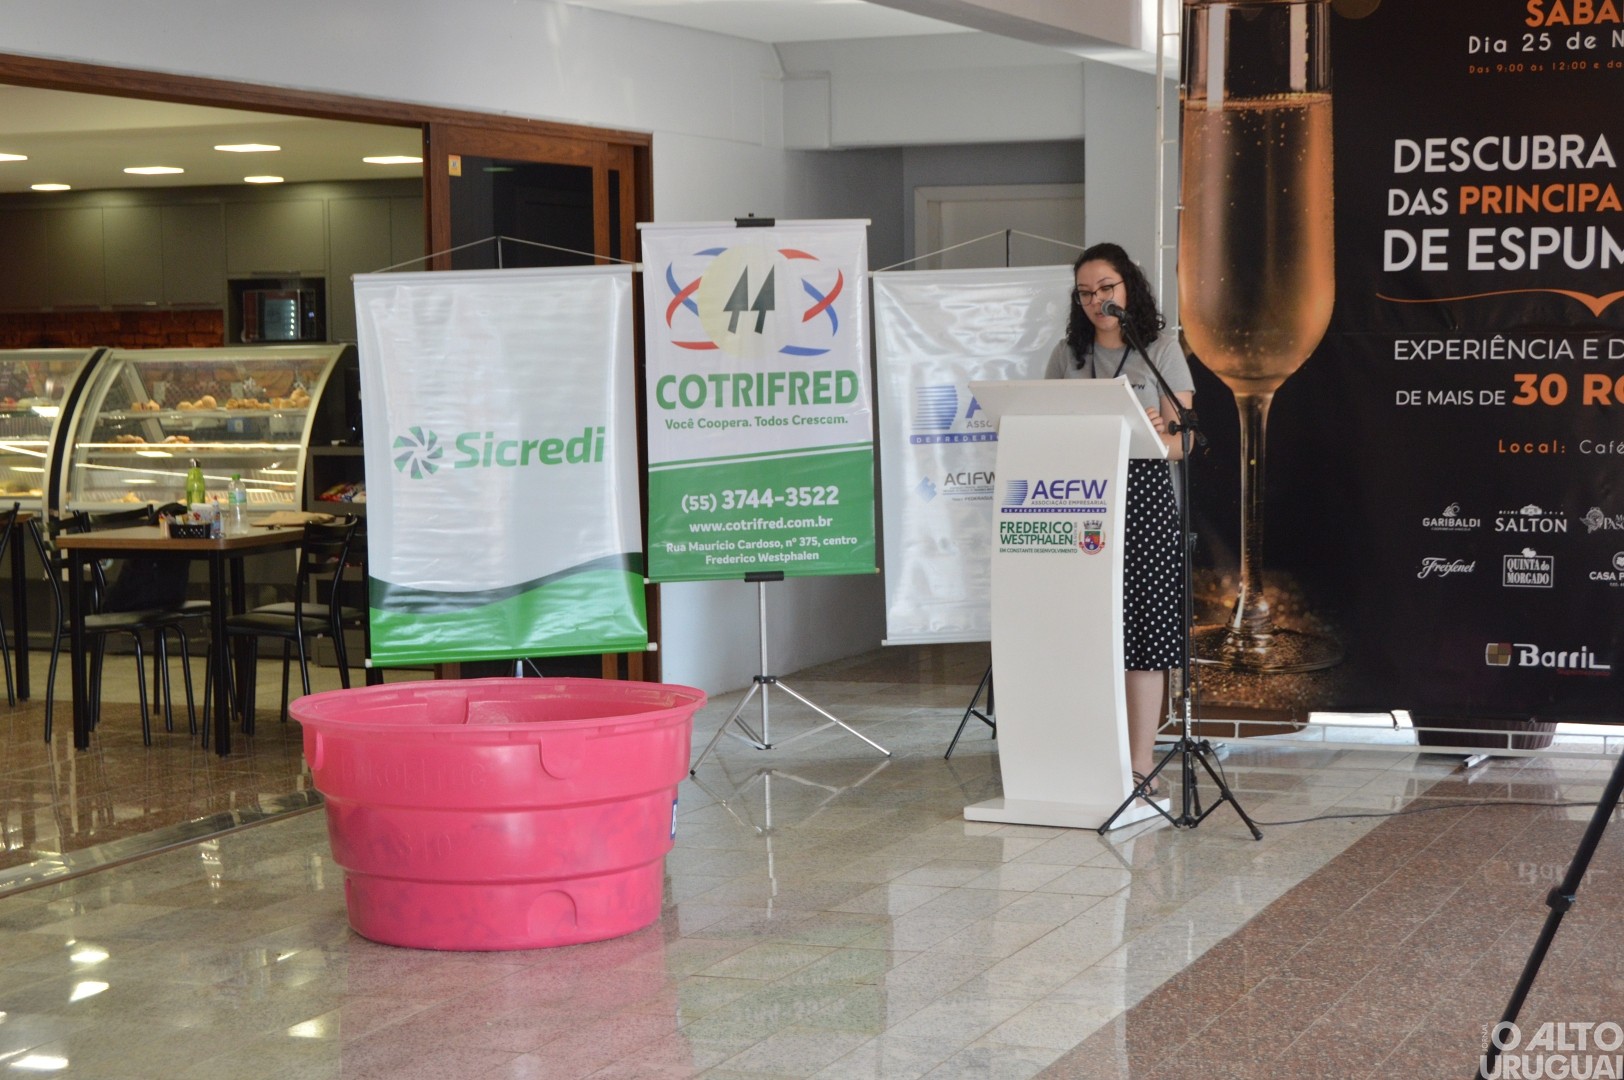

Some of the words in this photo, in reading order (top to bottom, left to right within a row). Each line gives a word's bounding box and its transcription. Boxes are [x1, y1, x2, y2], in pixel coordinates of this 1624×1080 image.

[1525, 0, 1624, 27] SABA
[1469, 36, 1507, 54] Dia
[1522, 33, 1552, 51] 25
[1566, 31, 1597, 50] de
[1469, 65, 1490, 74] Das
[1497, 63, 1524, 73] 9:00
[1552, 61, 1586, 71] 12:00
[1394, 133, 1617, 174] DESCUBRA
[1388, 187, 1449, 216] DAS
[1459, 182, 1623, 215] PRINCIPA
[1383, 228, 1449, 272] DE
[1394, 335, 1575, 361] EXPERIÊNCIA
[1583, 339, 1598, 360] E
[655, 369, 860, 411] COTRIFRED
[1396, 390, 1421, 406] DE
[1427, 390, 1474, 406] MAIS
[1479, 390, 1506, 406] DE
[1512, 373, 1568, 406] 30
[665, 418, 695, 430] Você
[697, 418, 752, 431] Coopera.
[754, 415, 789, 427] Todos
[791, 414, 848, 426] Crescem.
[454, 426, 606, 469] Sicredi
[1499, 439, 1566, 454] Local:
[1031, 480, 1108, 500] AEFW
[681, 492, 718, 514] (55)
[721, 485, 840, 510] 3744-3522
[689, 515, 833, 533] www.cotrifred.com.br
[1000, 521, 1073, 534] FREDERICO
[1422, 517, 1481, 528] GARIBALDI
[1494, 517, 1568, 533] SALTON
[666, 543, 686, 553] Rua
[688, 539, 735, 551] Maurício
[737, 537, 784, 549] Cardoso,
[800, 535, 821, 547] 375,
[823, 535, 858, 546] centro
[1000, 534, 1073, 545] WESTPHALEN
[705, 553, 755, 565] Frederico
[758, 551, 819, 564] Westphalen
[1507, 558, 1540, 572] QUINTA
[1540, 561, 1550, 571] do
[1417, 557, 1476, 579] Freixenet
[1589, 571, 1617, 580] CASA
[1507, 572, 1550, 584] MORGADO
